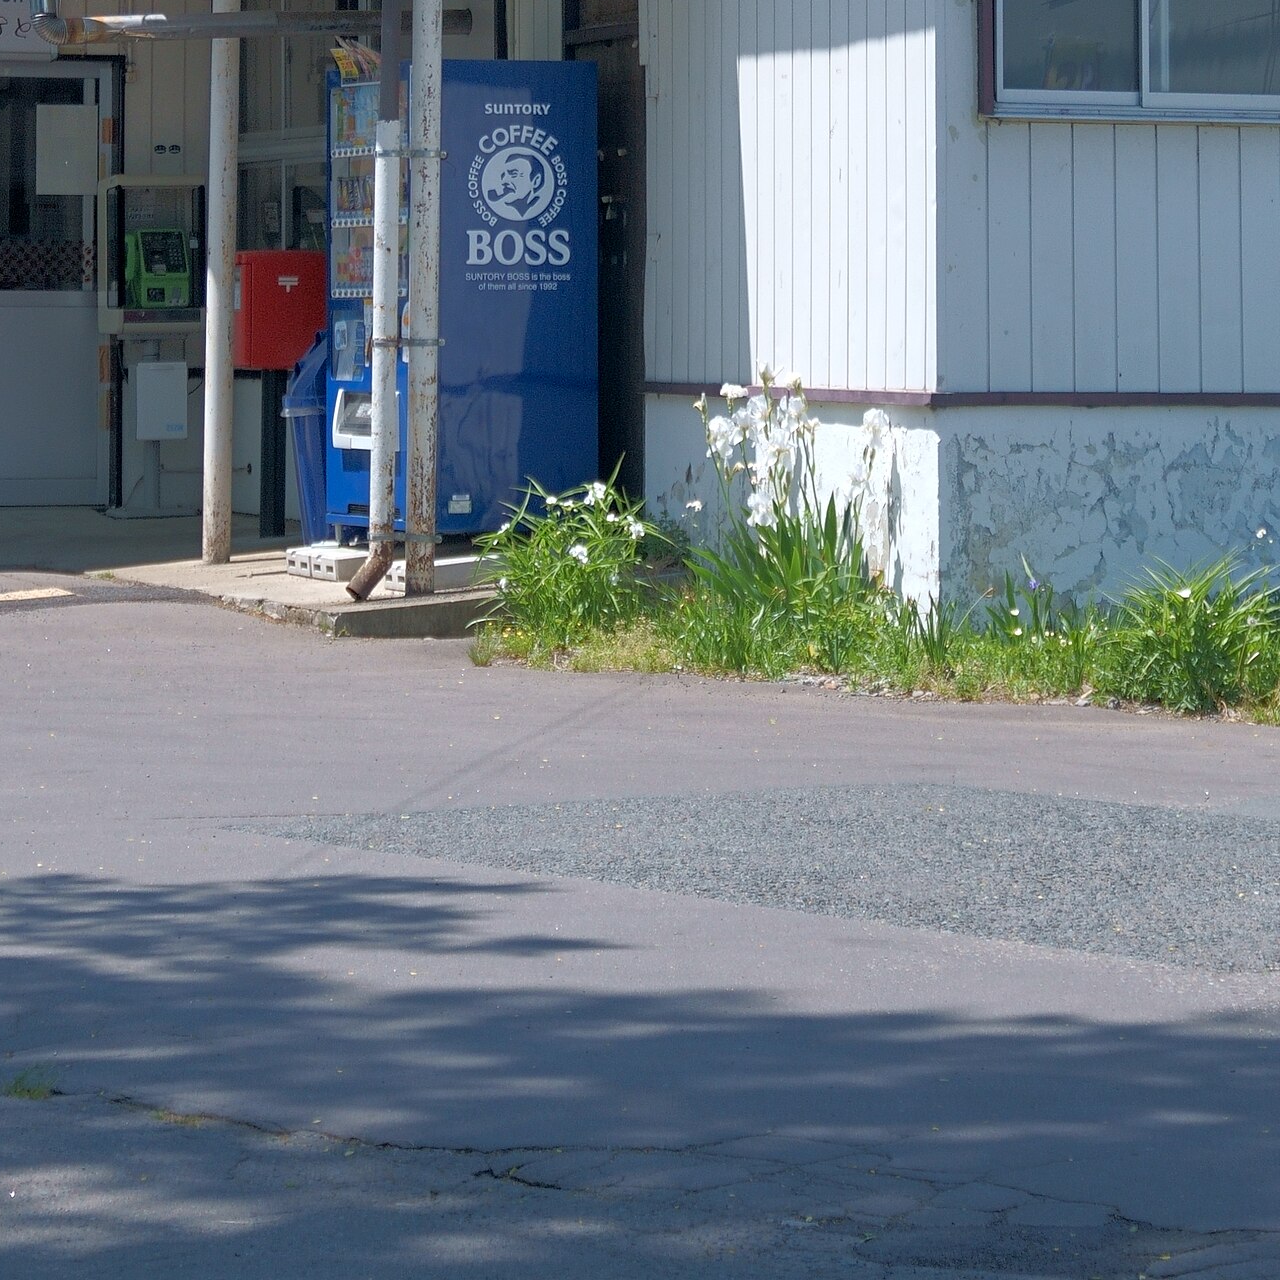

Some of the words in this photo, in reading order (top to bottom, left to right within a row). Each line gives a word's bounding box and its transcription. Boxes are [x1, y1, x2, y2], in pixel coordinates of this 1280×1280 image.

[484, 103, 551, 116] SUNTORY
[478, 124, 559, 156] COFFEE
[468, 155, 485, 199] COFFEE
[550, 155, 568, 186] BOSS
[472, 199, 498, 228] BOSS
[538, 189, 567, 228] COFFEE
[466, 229, 571, 266] BOSS
[465, 272, 505, 281] SUNTORY
[507, 272, 530, 281] BOSS
[531, 272, 538, 281] is
[539, 272, 551, 281] the
[552, 272, 571, 281] boss
[478, 282, 486, 291] of
[487, 282, 506, 291] them
[507, 282, 517, 291] all
[518, 282, 538, 291] since
[540, 282, 558, 291] 1992
